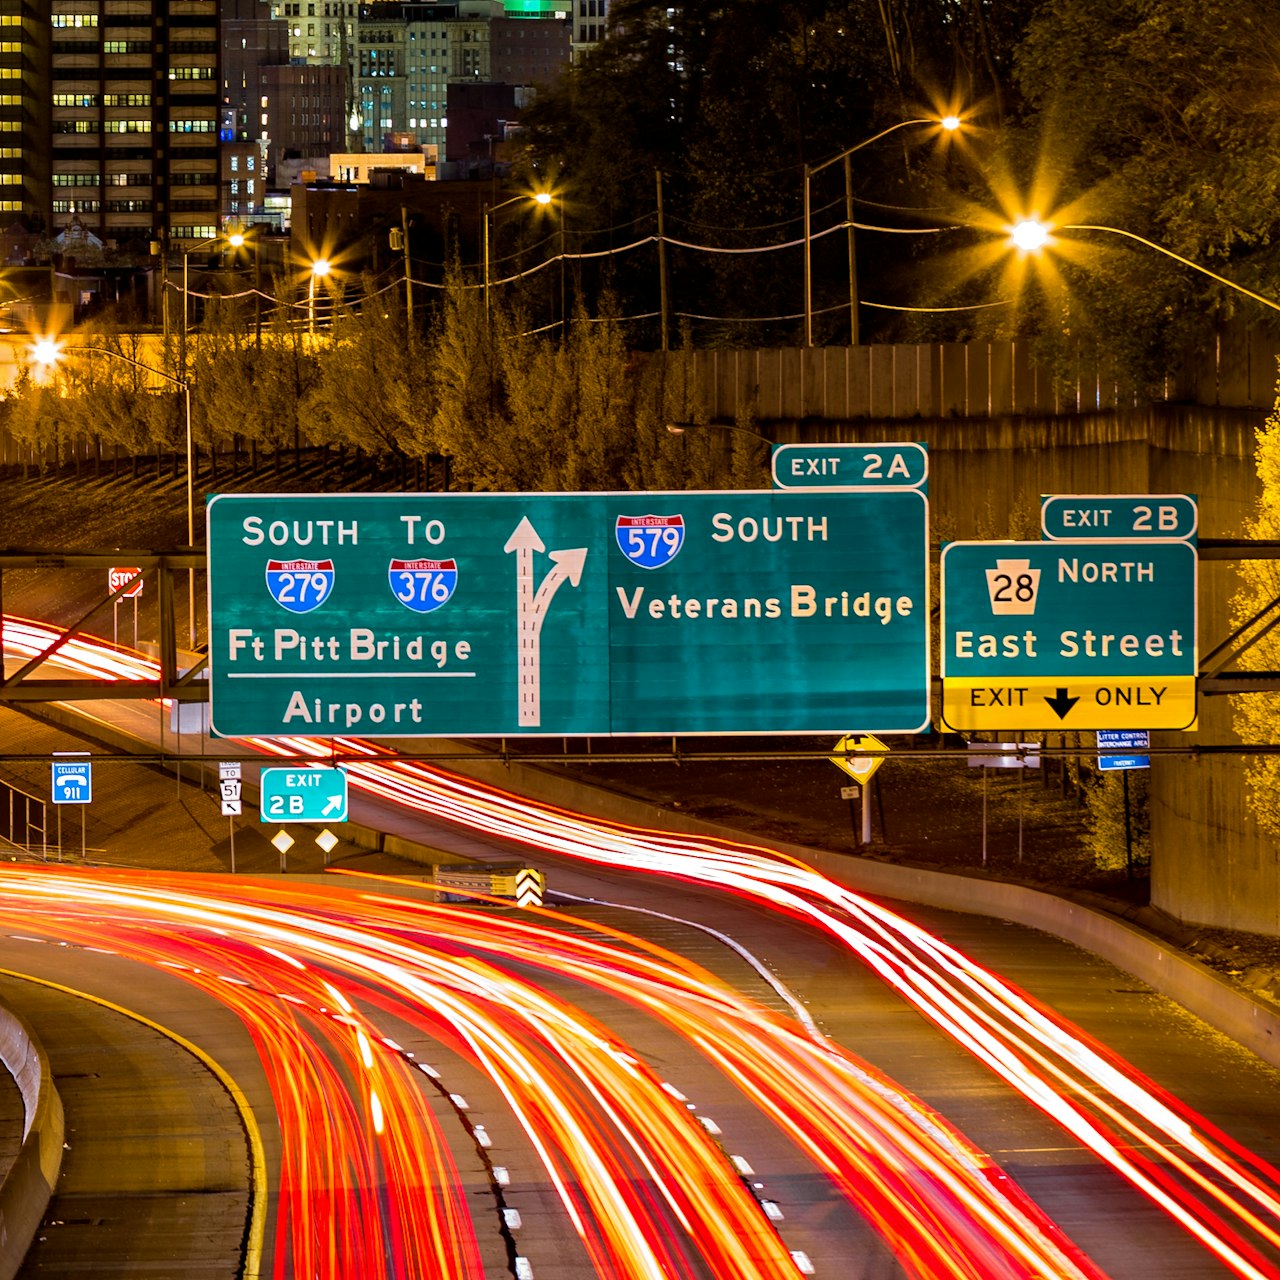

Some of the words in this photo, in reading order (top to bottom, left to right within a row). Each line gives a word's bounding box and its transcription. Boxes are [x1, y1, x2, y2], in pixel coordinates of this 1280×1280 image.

[791, 458, 839, 476] EXIT
[862, 454, 910, 479] 2A
[242, 516, 358, 547] SOUTH
[400, 515, 446, 544] TO
[631, 518, 668, 526] INTERSTATE
[1063, 510, 1112, 527] EXIT
[1132, 507, 1179, 531] 2B
[628, 528, 680, 558] 579
[712, 512, 828, 542] SOUTH
[282, 562, 318, 571] INTERSTATE
[404, 562, 442, 570] INTERSTATE
[112, 573, 137, 586] STO
[278, 573, 327, 603] 279
[398, 573, 449, 602] 376
[994, 574, 1034, 602] 28
[1058, 559, 1154, 583] NORTH
[616, 587, 781, 619] Veterans
[791, 585, 913, 625] Bridge
[229, 629, 264, 661] Ft
[275, 629, 340, 661] Pitt
[350, 629, 472, 668] Bridge
[956, 631, 1037, 658] East
[1060, 630, 1183, 657] Street
[971, 688, 1029, 706] EXIT
[1096, 687, 1168, 706] ONLY
[282, 691, 422, 728] Airport
[64, 787, 80, 799] 911
[224, 785, 238, 796] 51
[286, 774, 322, 787] EXIT
